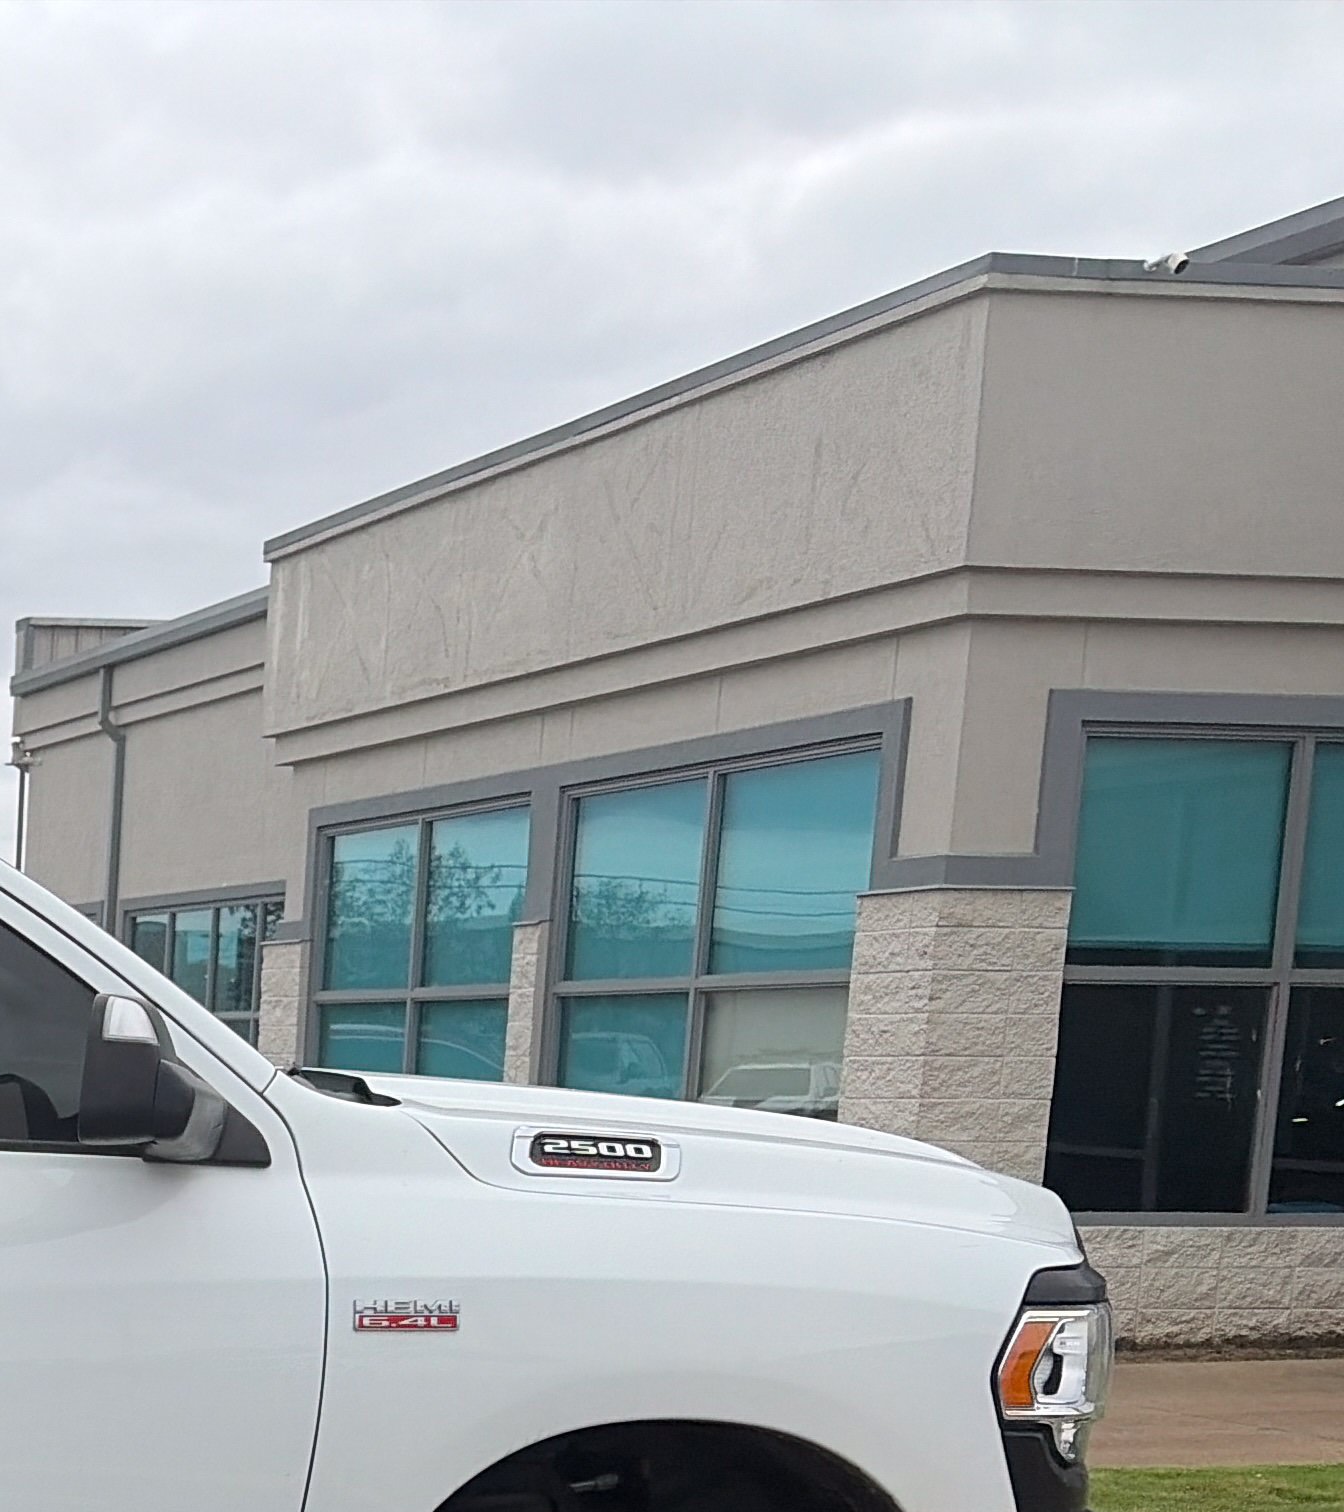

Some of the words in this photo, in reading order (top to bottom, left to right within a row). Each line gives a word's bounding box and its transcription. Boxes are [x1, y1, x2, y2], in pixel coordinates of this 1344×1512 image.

[542, 1139, 652, 1158] 2500
[353, 1299, 460, 1314] HEMI
[361, 1316, 453, 1329] 6.4L
